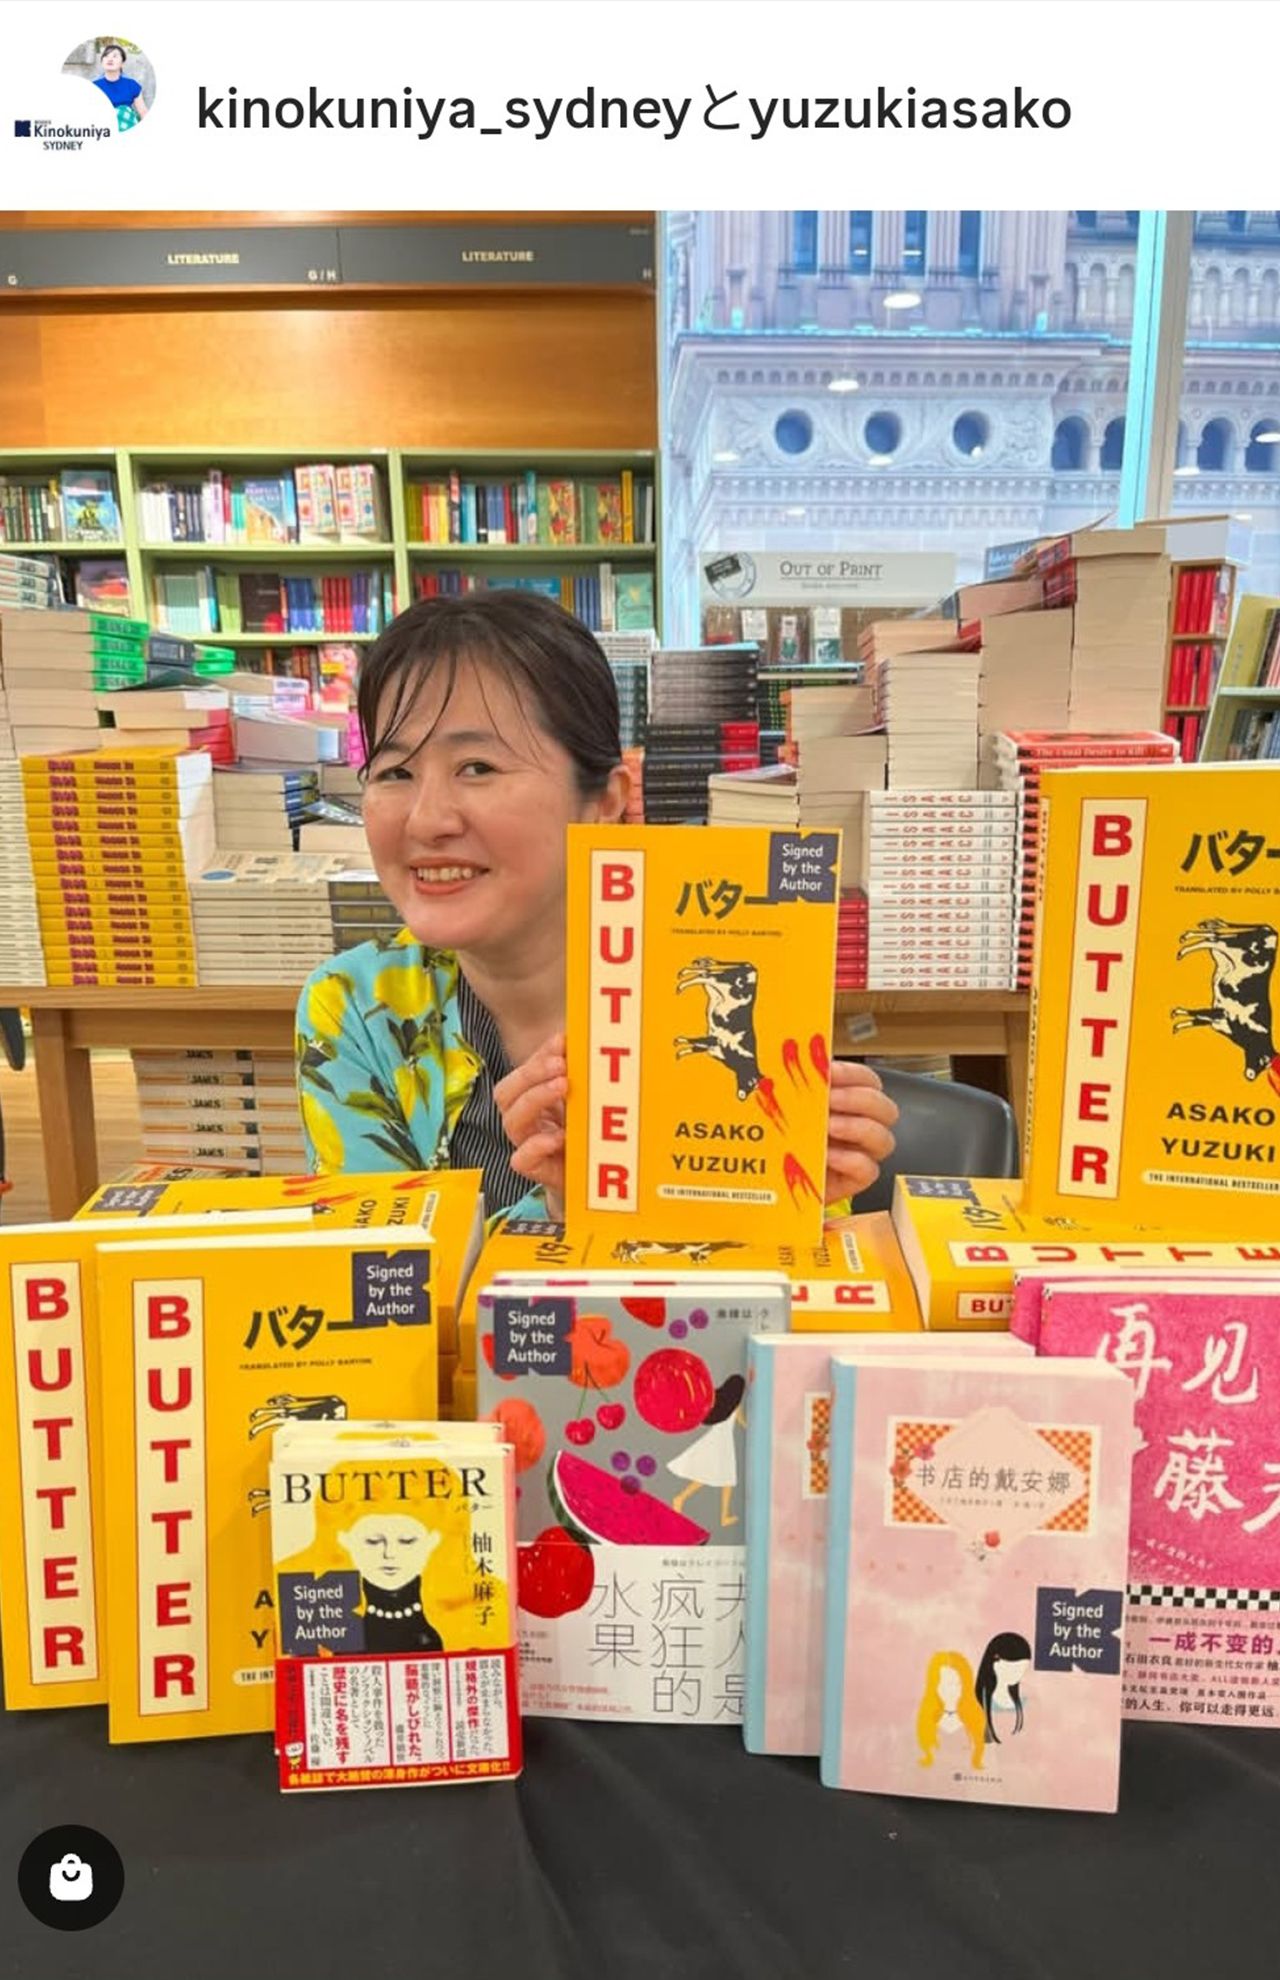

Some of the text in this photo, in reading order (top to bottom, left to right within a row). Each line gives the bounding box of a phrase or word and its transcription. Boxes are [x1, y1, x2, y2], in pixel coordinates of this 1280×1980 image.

[167, 253, 240, 265] LITERATURE
[461, 251, 534, 262] LITERATURE
[8, 275, 18, 285] G
[782, 842, 824, 860] Signed
[782, 861, 821, 877] by the
[779, 877, 823, 892] Author
[674, 879, 778, 921] バター
[1071, 814, 1133, 1185] BUTTER
[597, 863, 635, 1200] BUTTER
[1166, 1102, 1276, 1128] ASAKO
[674, 1121, 764, 1142] ASAKO
[1161, 1137, 1275, 1163] YUZUKI
[672, 1153, 766, 1175] YUZUKI
[1149, 1173, 1164, 1183] THE
[1166, 1174, 1229, 1188] INTERNATIONAL
[663, 1187, 772, 1201] THE INTERNATIONAL BESTSELLER
[366, 1264, 414, 1283] Signed
[368, 1283, 413, 1301] by the
[365, 1301, 416, 1317] Author
[243, 1304, 372, 1351] バター
[508, 1310, 556, 1329] Signed
[509, 1330, 555, 1347] by the
[507, 1348, 557, 1364] Author
[25, 1277, 86, 1669] BUTTER
[915, 1464, 1071, 1495] 书店的戴安娜
[282, 1467, 490, 1505] BUTTER
[146, 1294, 196, 1700] BUTTER
[472, 1531, 496, 1627] 柚木麻子
[294, 1584, 344, 1603] Signed
[296, 1604, 344, 1621] by the
[587, 1571, 642, 1669] 水果
[1052, 1601, 1104, 1621] Signed
[295, 1625, 348, 1641] Author
[1053, 1622, 1101, 1641] by the
[651, 1572, 704, 1718] 疯狂的
[1049, 1643, 1104, 1660] Author
[1148, 1631, 1280, 1656] 一成不变的
